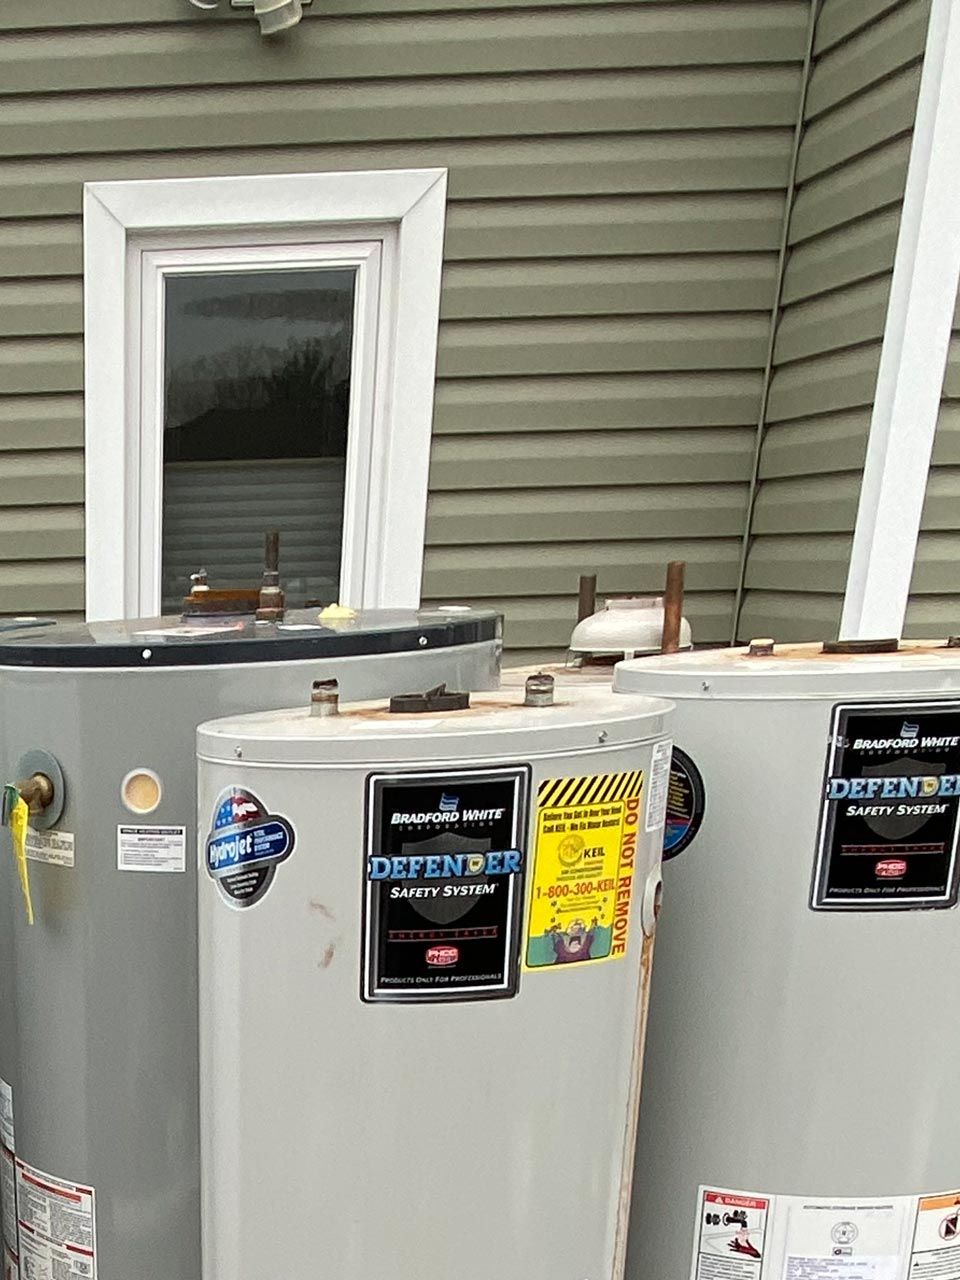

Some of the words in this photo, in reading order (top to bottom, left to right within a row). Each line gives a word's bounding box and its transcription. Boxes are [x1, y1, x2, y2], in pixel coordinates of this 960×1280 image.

[853, 738, 919, 750] BRADFORD
[920, 736, 960, 747] WHITE
[390, 812, 460, 825] BRADFORD
[462, 808, 503, 821] WHITE
[625, 798, 640, 826] DO
[846, 805, 895, 817] SAFETY
[896, 804, 947, 816] SYSTEM
[209, 834, 252, 868] Hydrojet
[583, 847, 605, 859] KEIL
[620, 832, 637, 869] NOT
[369, 849, 522, 880] DEFENDER
[390, 886, 440, 899] SAFETY
[443, 884, 496, 897] SYSTEM
[536, 878, 615, 899] 1-800-300-KEIL
[611, 875, 633, 956] REMOVE
[380, 976, 415, 984] PRODUCTS
[450, 973, 502, 982] PROFESSIONALS
